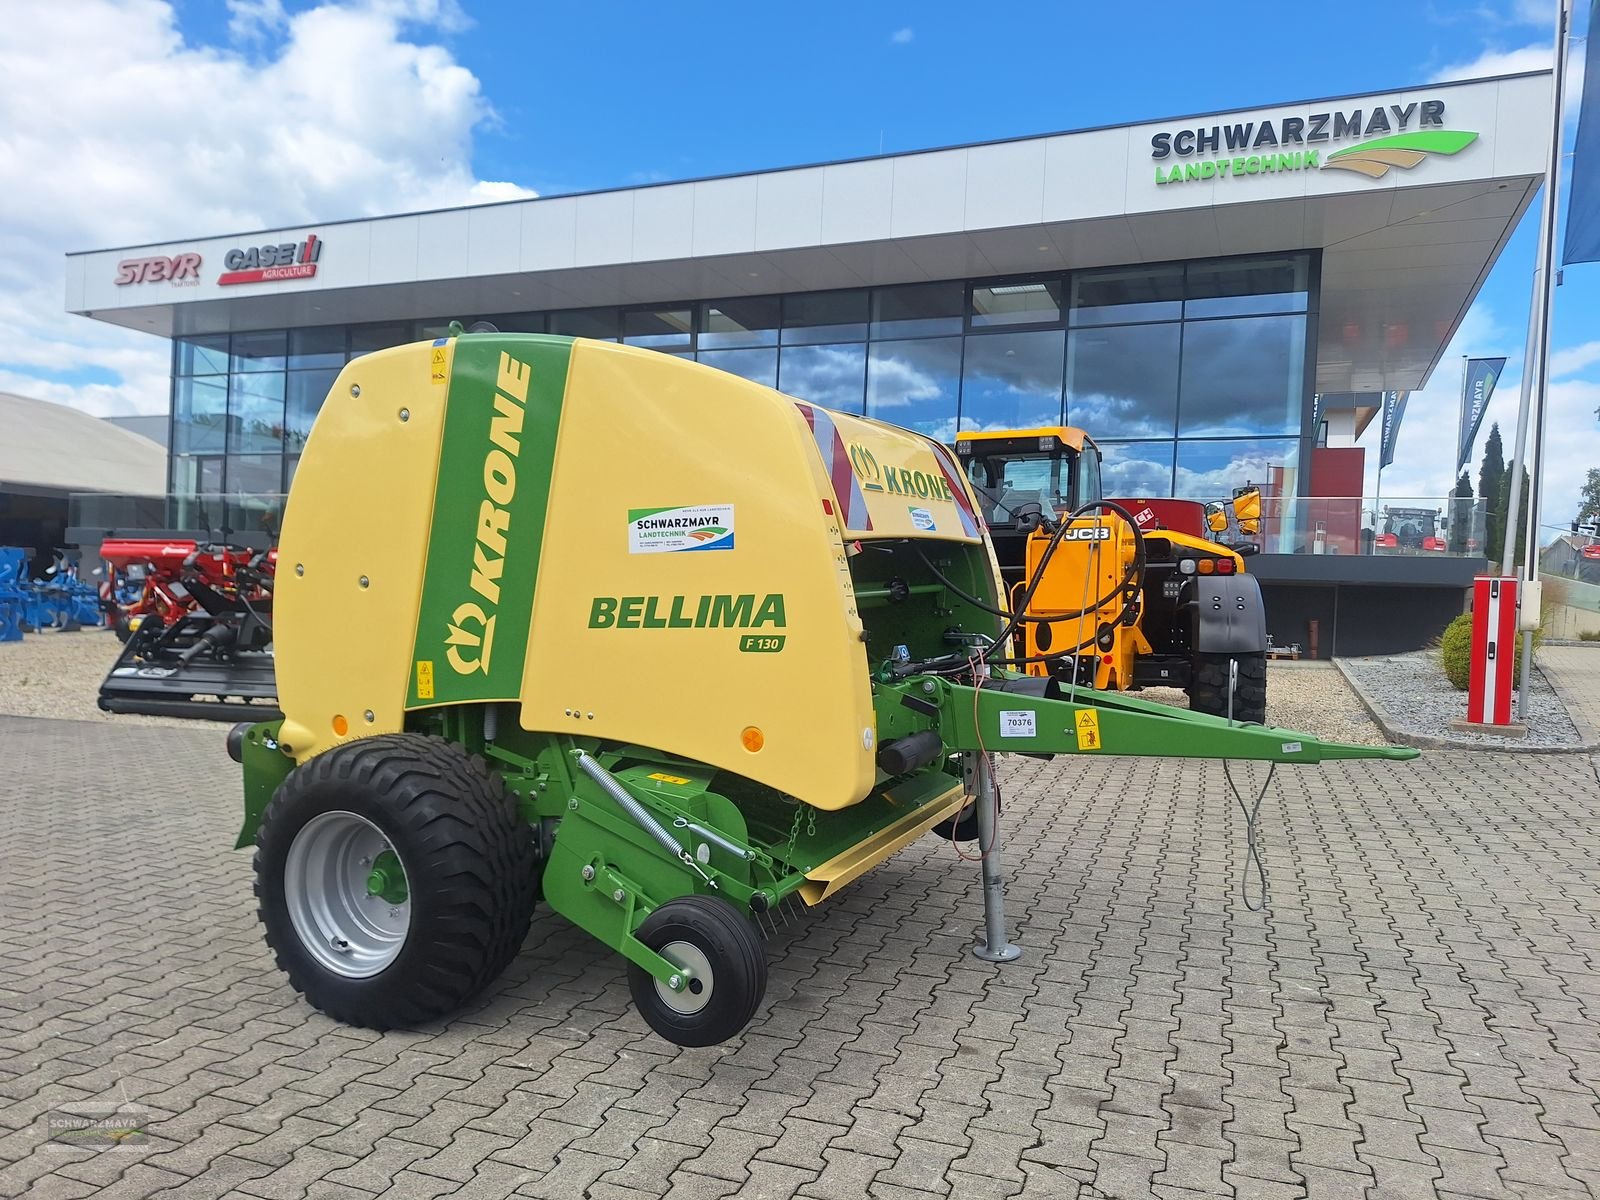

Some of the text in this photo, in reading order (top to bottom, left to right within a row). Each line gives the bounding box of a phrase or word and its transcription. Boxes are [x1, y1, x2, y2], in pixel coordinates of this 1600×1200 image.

[1151, 99, 1446, 160] SCHWARZMAYR
[1155, 149, 1320, 185] LANDTECHNIK
[114, 252, 202, 286] STEYR
[224, 243, 296, 271] CASE
[262, 266, 312, 280] AGRICULTURE
[470, 351, 531, 605] KRONE
[883, 465, 953, 501] KRONE
[637, 516, 720, 530] SCHWARZMAYR
[639, 530, 687, 539] LANDTECHNIK
[1065, 528, 1109, 540] JCB
[588, 594, 786, 629] BELLIMA
[746, 639, 779, 650] F 130
[1007, 718, 1032, 726] 70376
